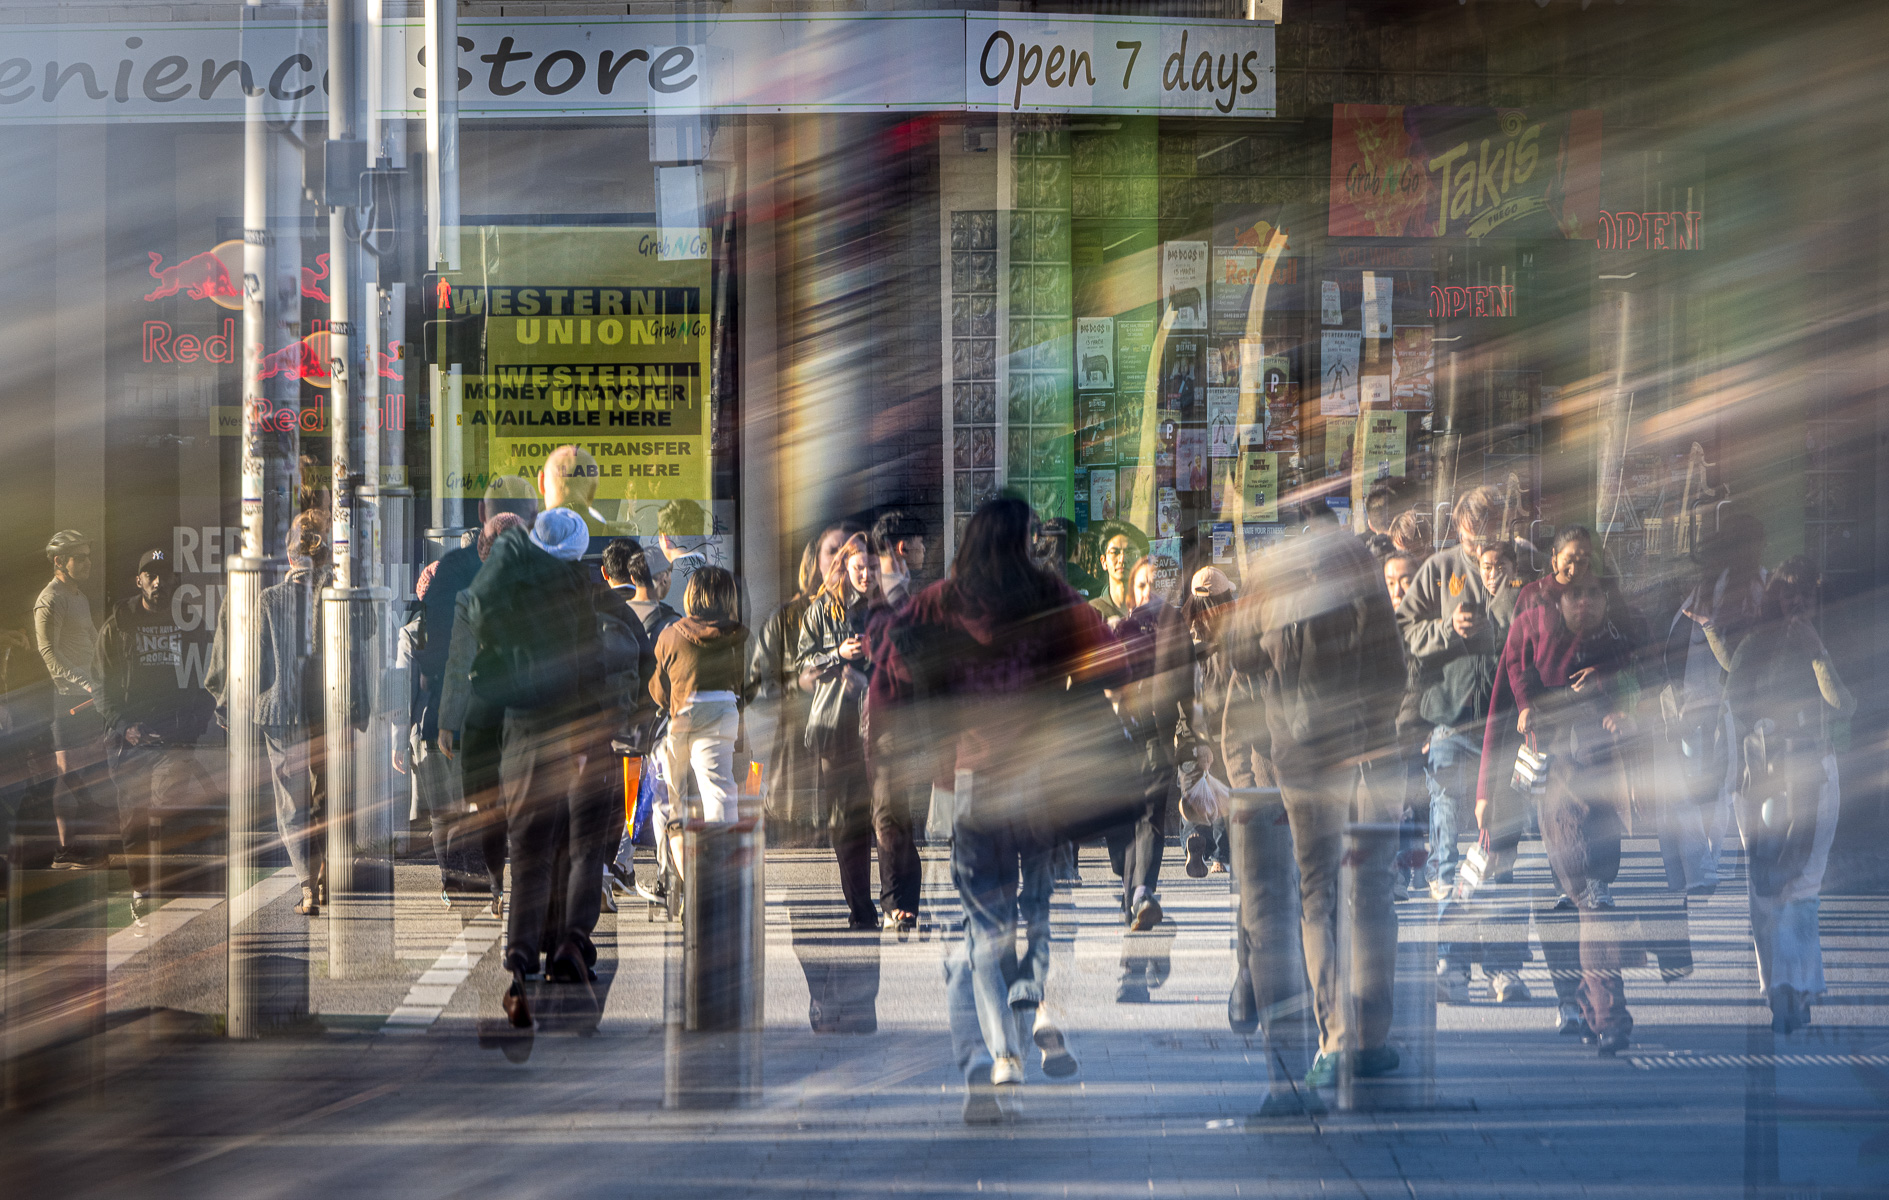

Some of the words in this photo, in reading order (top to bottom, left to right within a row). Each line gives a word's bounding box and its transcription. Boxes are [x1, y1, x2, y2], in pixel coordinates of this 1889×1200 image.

[0, 36, 329, 104] enienc
[413, 36, 698, 98] Store
[979, 30, 1096, 110] Open
[1116, 41, 1142, 89] 7
[1162, 29, 1257, 113] days
[1487, 203, 1518, 226] FUEGO
[1597, 210, 1701, 250] OPEN
[638, 234, 670, 257] Grab
[690, 235, 707, 256] Go
[1225, 258, 1261, 285] Red
[1264, 258, 1297, 285] Bull
[451, 288, 656, 315] WESTERN
[1429, 285, 1514, 317] OPEN
[143, 318, 234, 363] Red
[516, 318, 656, 345] UNION
[650, 320, 677, 339] Grab
[677, 321, 692, 336] N
[691, 320, 707, 338] Go
[498, 365, 666, 388] WESTERN
[464, 383, 551, 400] MONEY
[558, 383, 686, 401] TRANSFER
[552, 390, 666, 411] UNION
[250, 394, 323, 433] Red
[471, 410, 601, 426] AVAILABLE
[609, 411, 672, 427] HERE
[587, 442, 691, 456] TRANSFER
[446, 472, 473, 490] Grab
[488, 472, 503, 488] Go
[518, 465, 622, 478] AVILABLE
[629, 464, 680, 476] HERE
[1254, 526, 1266, 535] YOUR
[1152, 568, 1179, 579] SCOTT
[1154, 557, 1175, 568] SAVE
[1155, 578, 1176, 588] REEF
